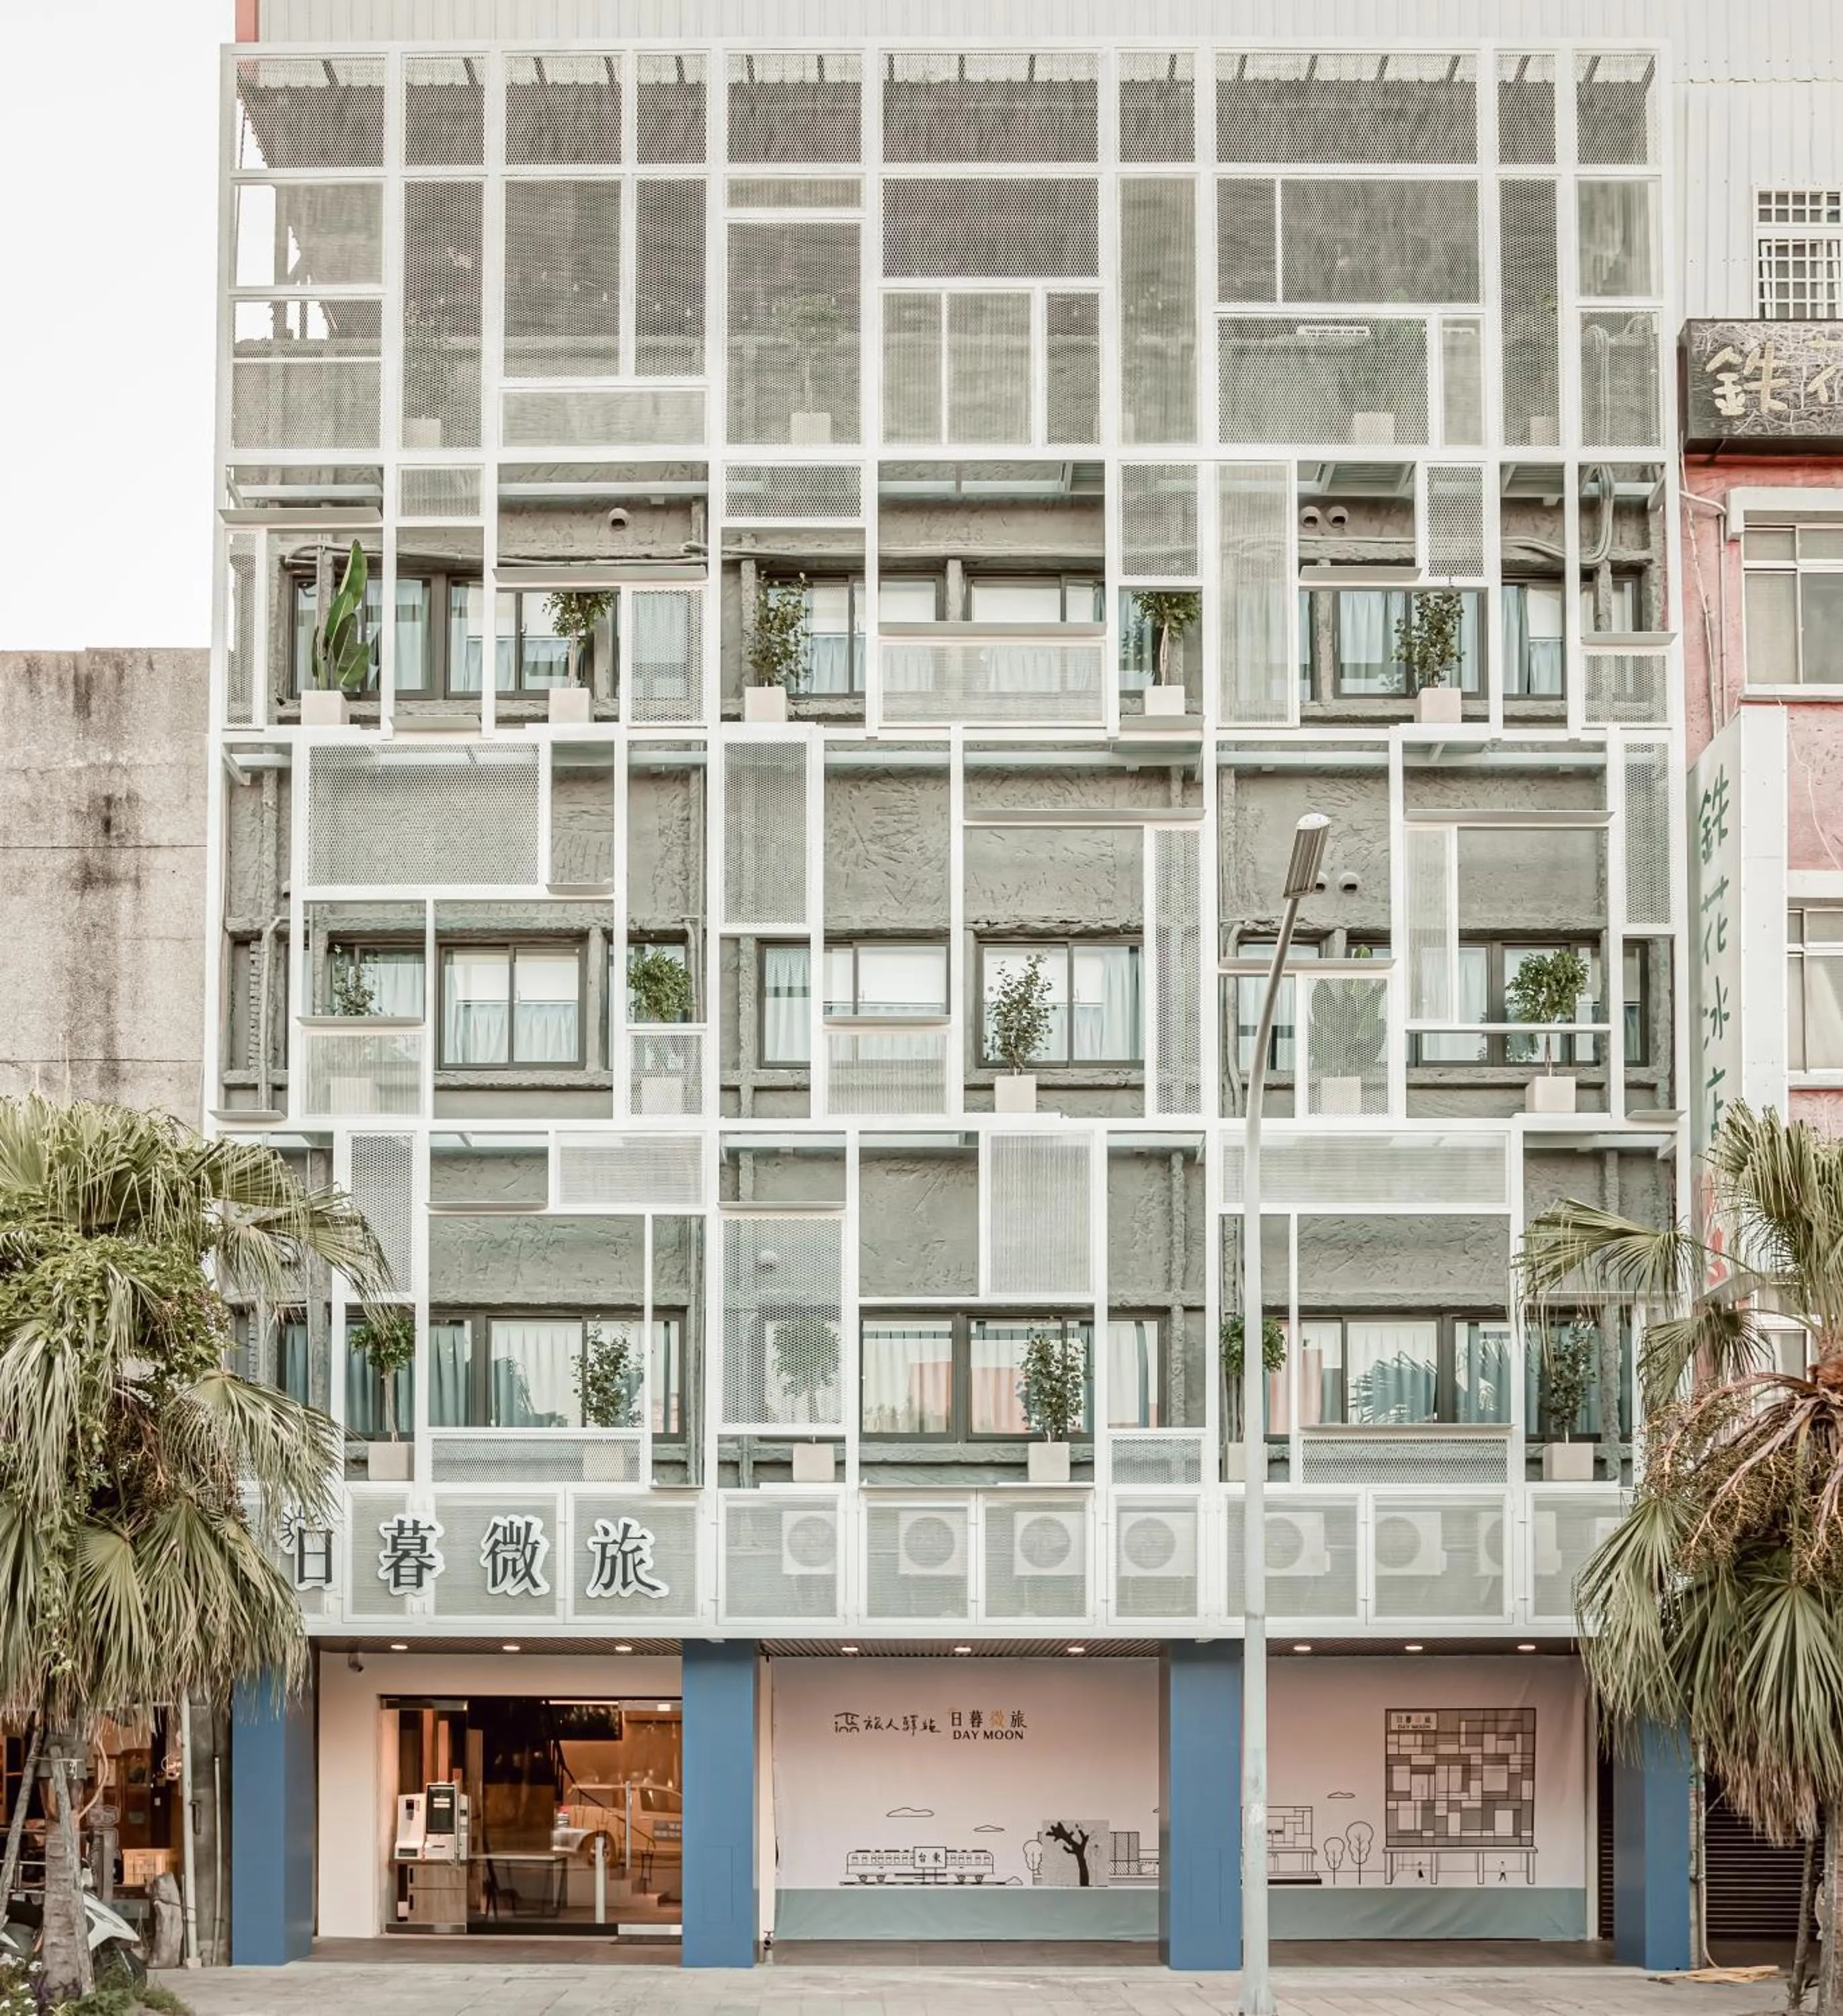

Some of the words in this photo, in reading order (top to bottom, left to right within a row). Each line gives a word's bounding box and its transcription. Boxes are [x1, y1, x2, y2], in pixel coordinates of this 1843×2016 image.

[297, 1517, 661, 1591] 日暮微旅
[951, 1709, 1028, 1728] 日暮微旅
[953, 1730, 979, 1740] DAY
[983, 1730, 1024, 1740] MOON
